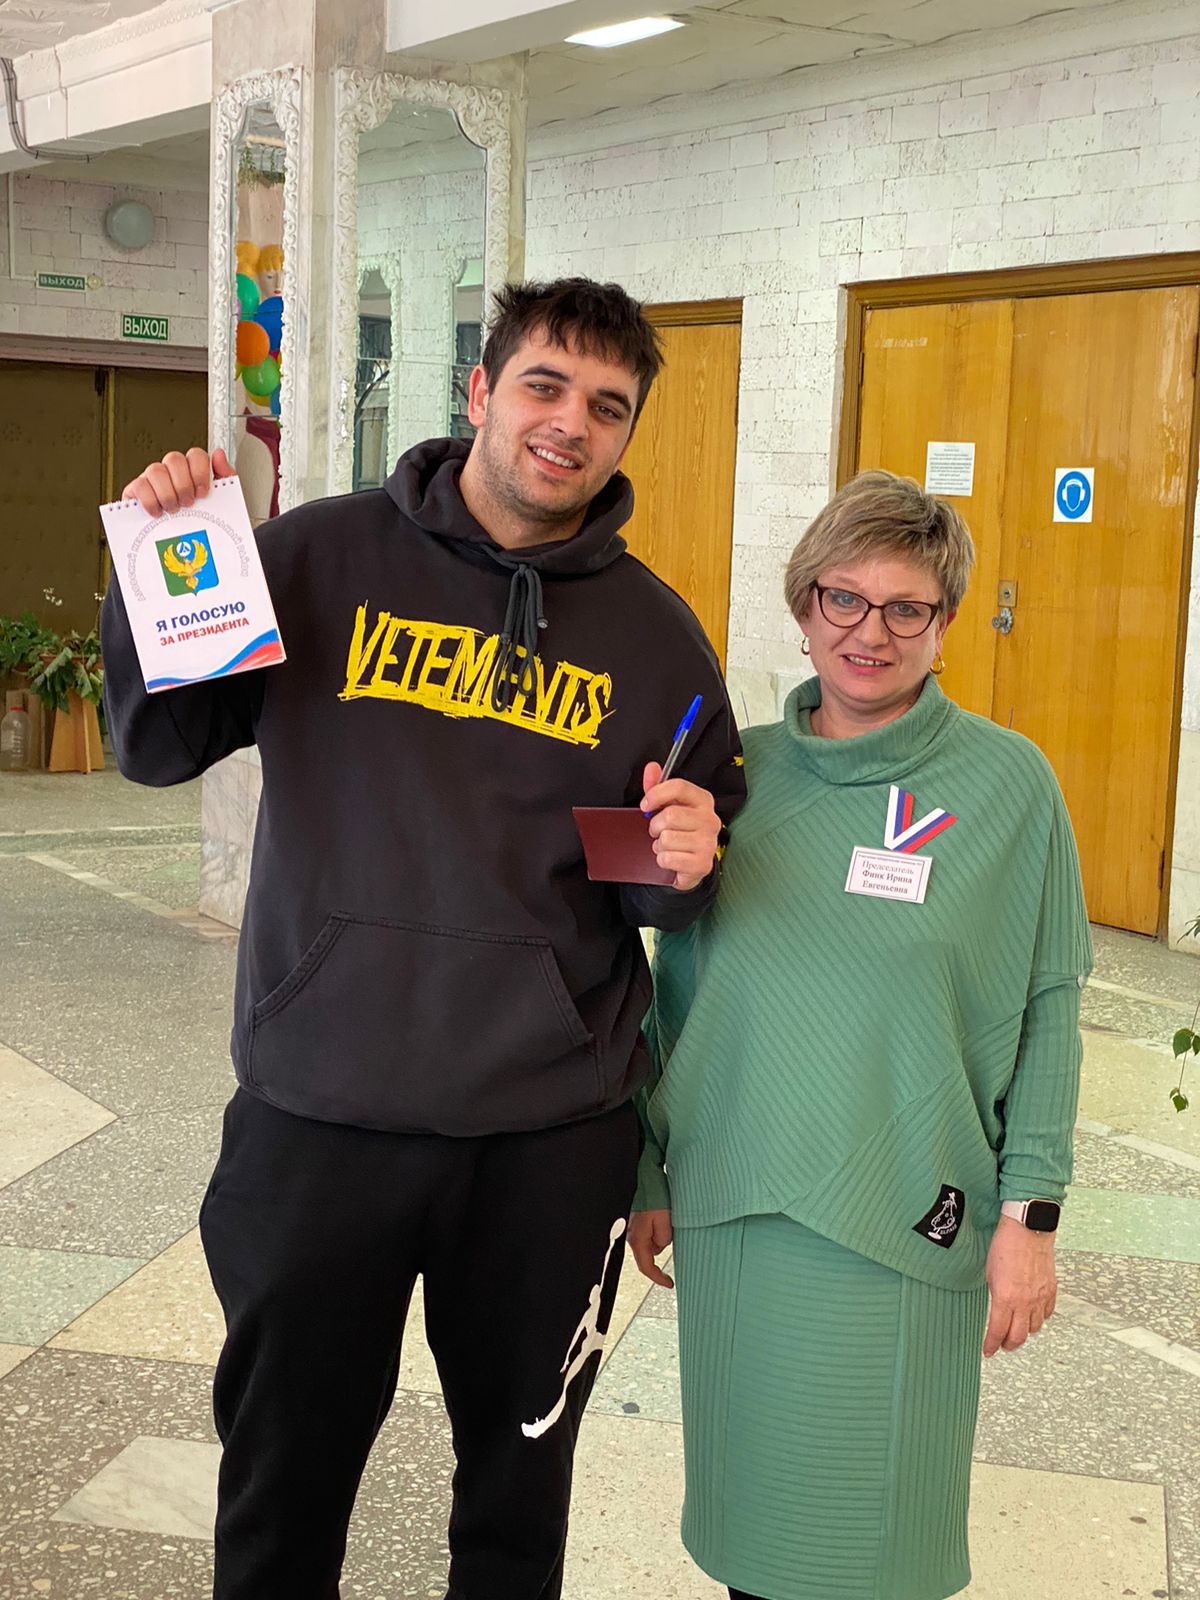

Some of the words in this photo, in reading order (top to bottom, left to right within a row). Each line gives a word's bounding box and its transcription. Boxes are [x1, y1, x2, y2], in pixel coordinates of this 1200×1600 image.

[40, 275, 84, 288] ВЫХОД
[124, 317, 167, 338] ВЫХОД
[155, 620, 168, 632] Я
[171, 601, 246, 629] ГОЛОСУЮ
[160, 636, 175, 646] ЗА
[177, 617, 250, 642] ПРЕЗИДЕНТА
[338, 600, 614, 744] VETEMENTS
[862, 860, 914, 875] Председатель
[862, 870, 885, 880] Финк
[886, 873, 913, 884] Ирина
[862, 880, 908, 894] Евгеньевна
